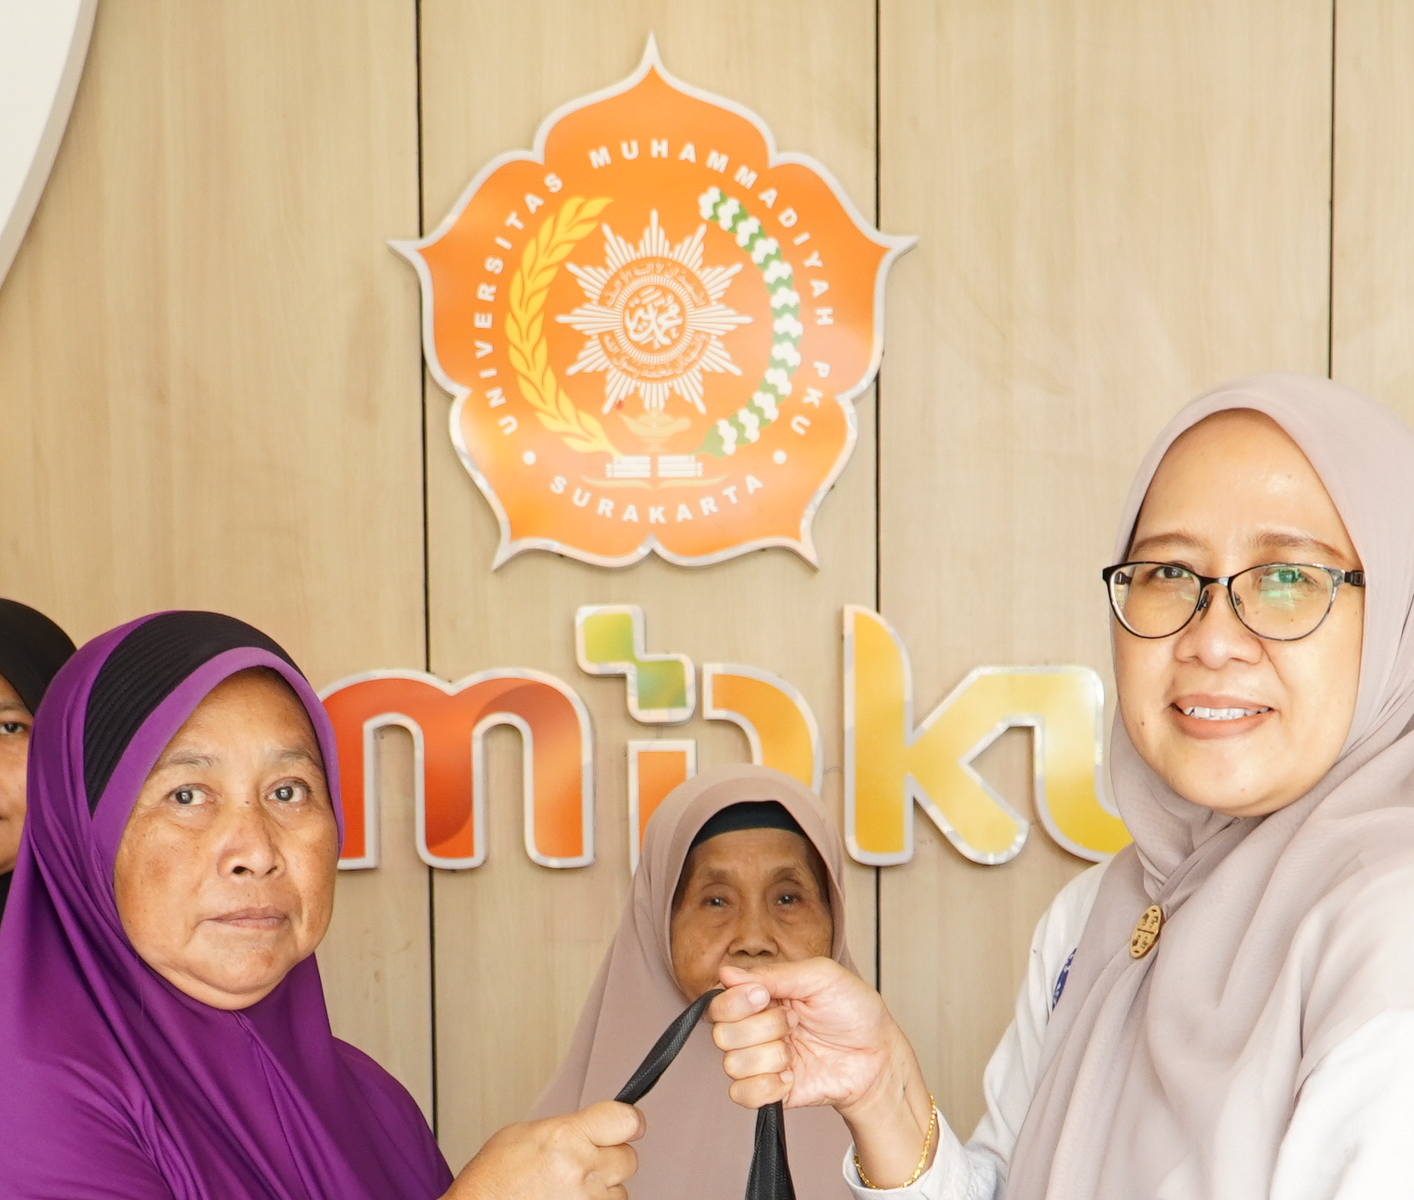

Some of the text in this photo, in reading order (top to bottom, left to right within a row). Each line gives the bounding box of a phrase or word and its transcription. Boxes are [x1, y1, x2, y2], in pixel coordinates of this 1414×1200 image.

[474, 138, 835, 436] UNIVERSITAS MUHAMMADIYAH PKU
[549, 473, 763, 524] SURAKARTA
